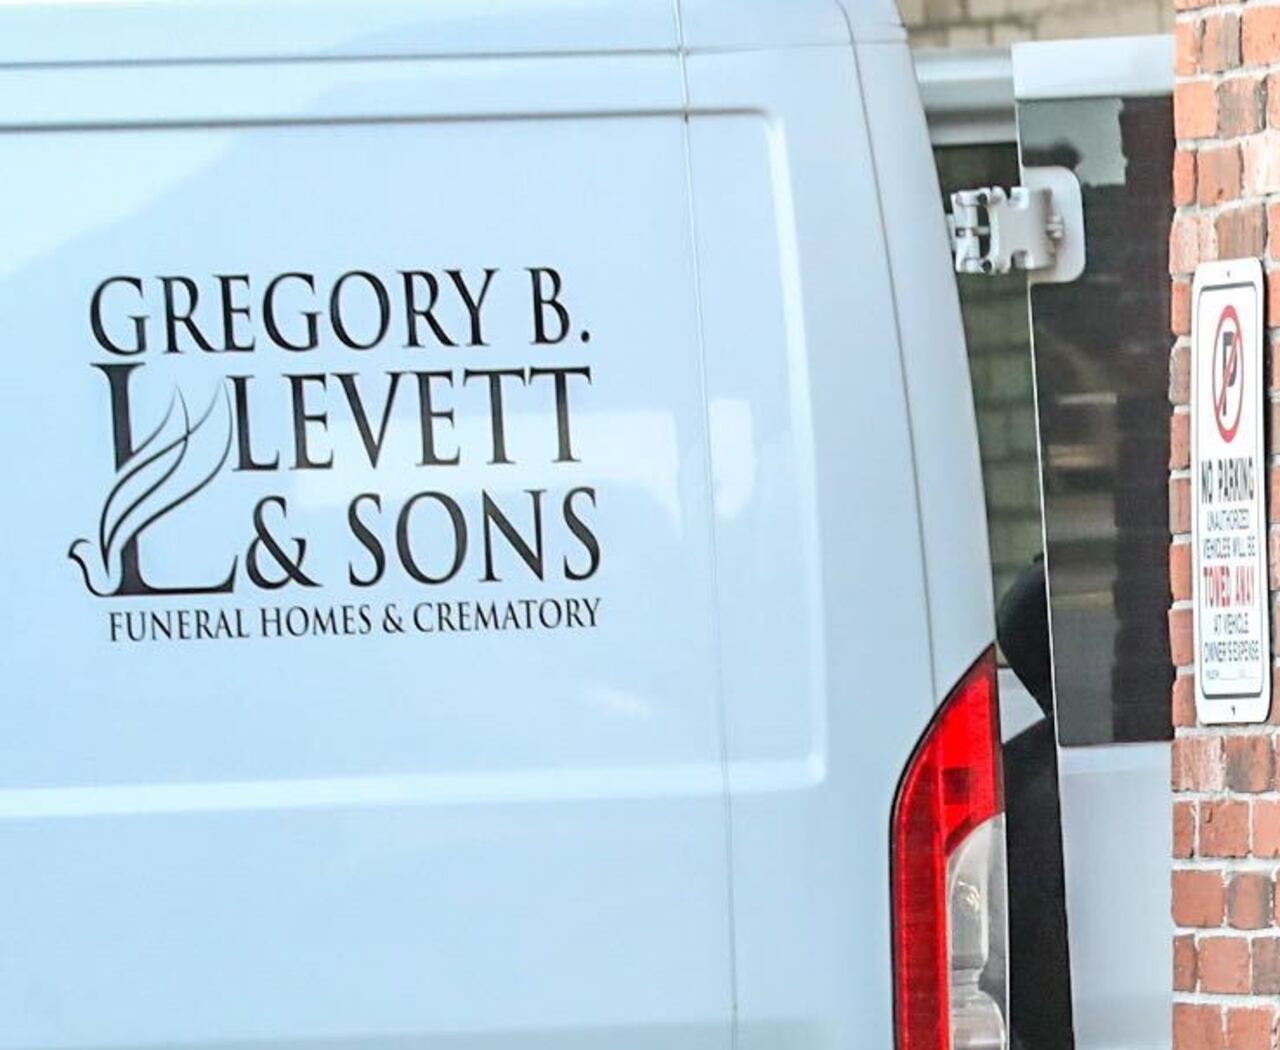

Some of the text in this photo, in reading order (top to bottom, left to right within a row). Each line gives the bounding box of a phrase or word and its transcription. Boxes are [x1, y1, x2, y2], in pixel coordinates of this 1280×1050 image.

[89, 267, 590, 356] GREGORY B.
[225, 366, 592, 471] LEVETT
[1201, 457, 1254, 503] NO PARKING
[245, 487, 601, 589] & SONS
[1203, 536, 1256, 559] VEHICLES WILL BE
[1203, 565, 1255, 608] TOWED AWAY
[109, 597, 601, 642] FUNERAL HOMES & CREMATORY
